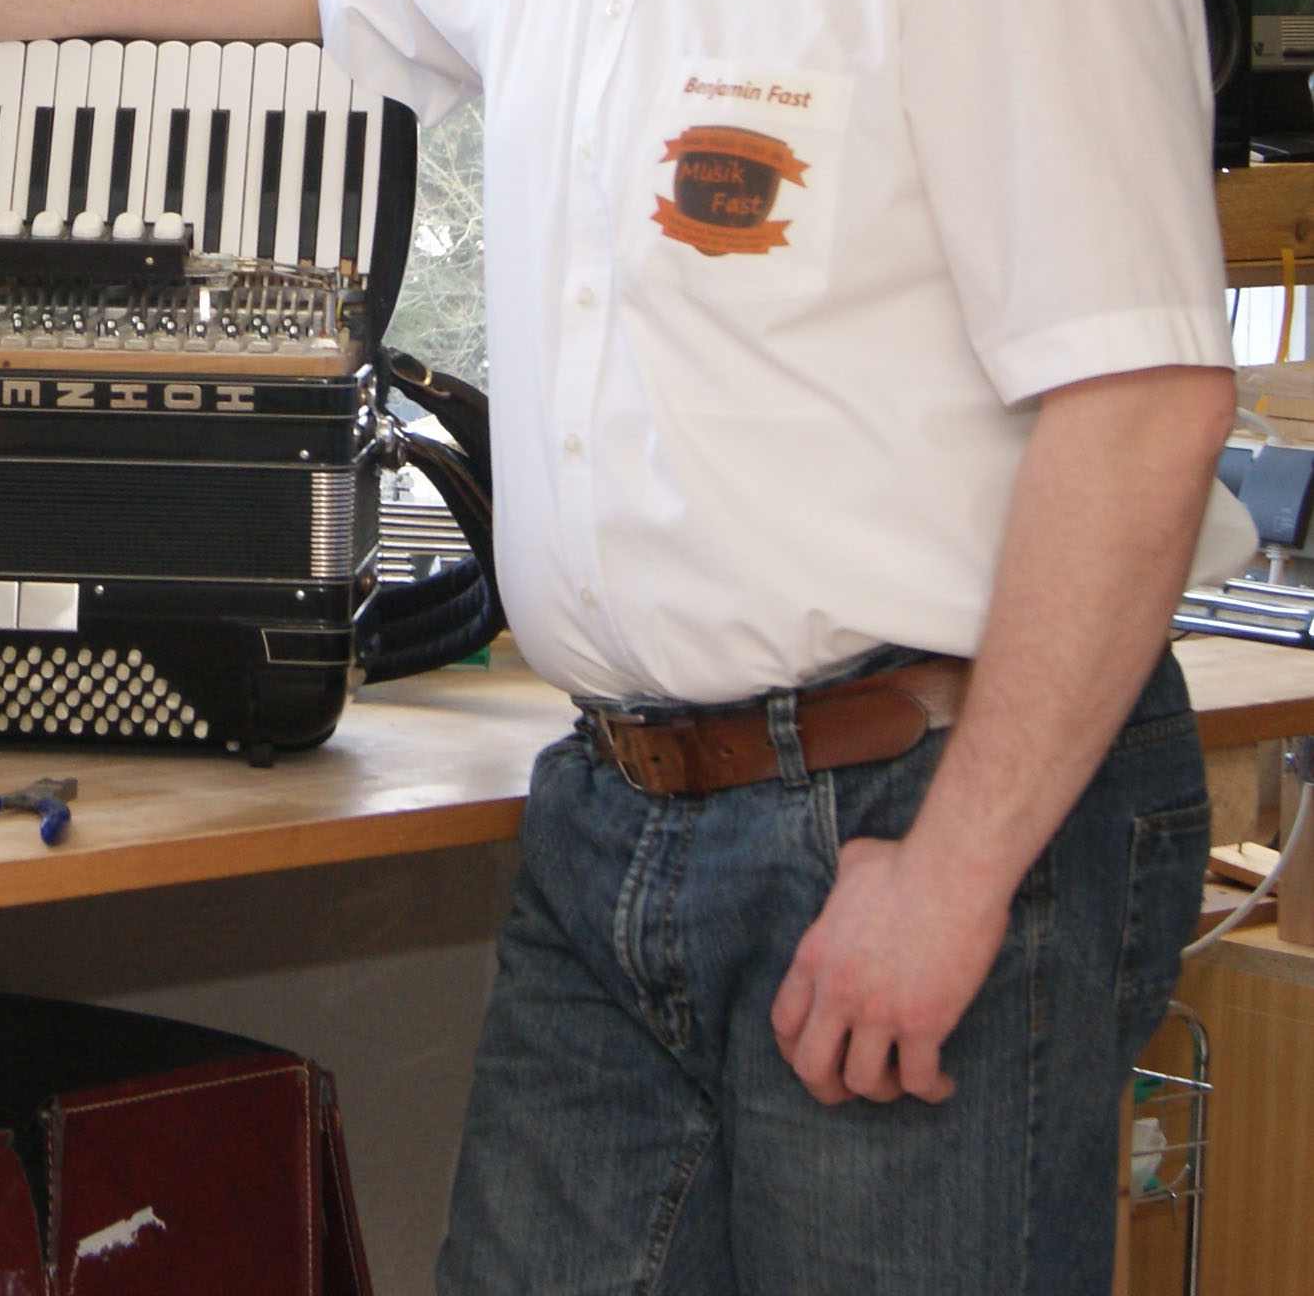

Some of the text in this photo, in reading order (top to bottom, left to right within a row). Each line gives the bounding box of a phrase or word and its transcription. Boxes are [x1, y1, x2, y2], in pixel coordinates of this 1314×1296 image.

[684, 77, 812, 108] Benjamin Fast
[680, 160, 746, 185] Musik
[710, 191, 763, 216] Fast
